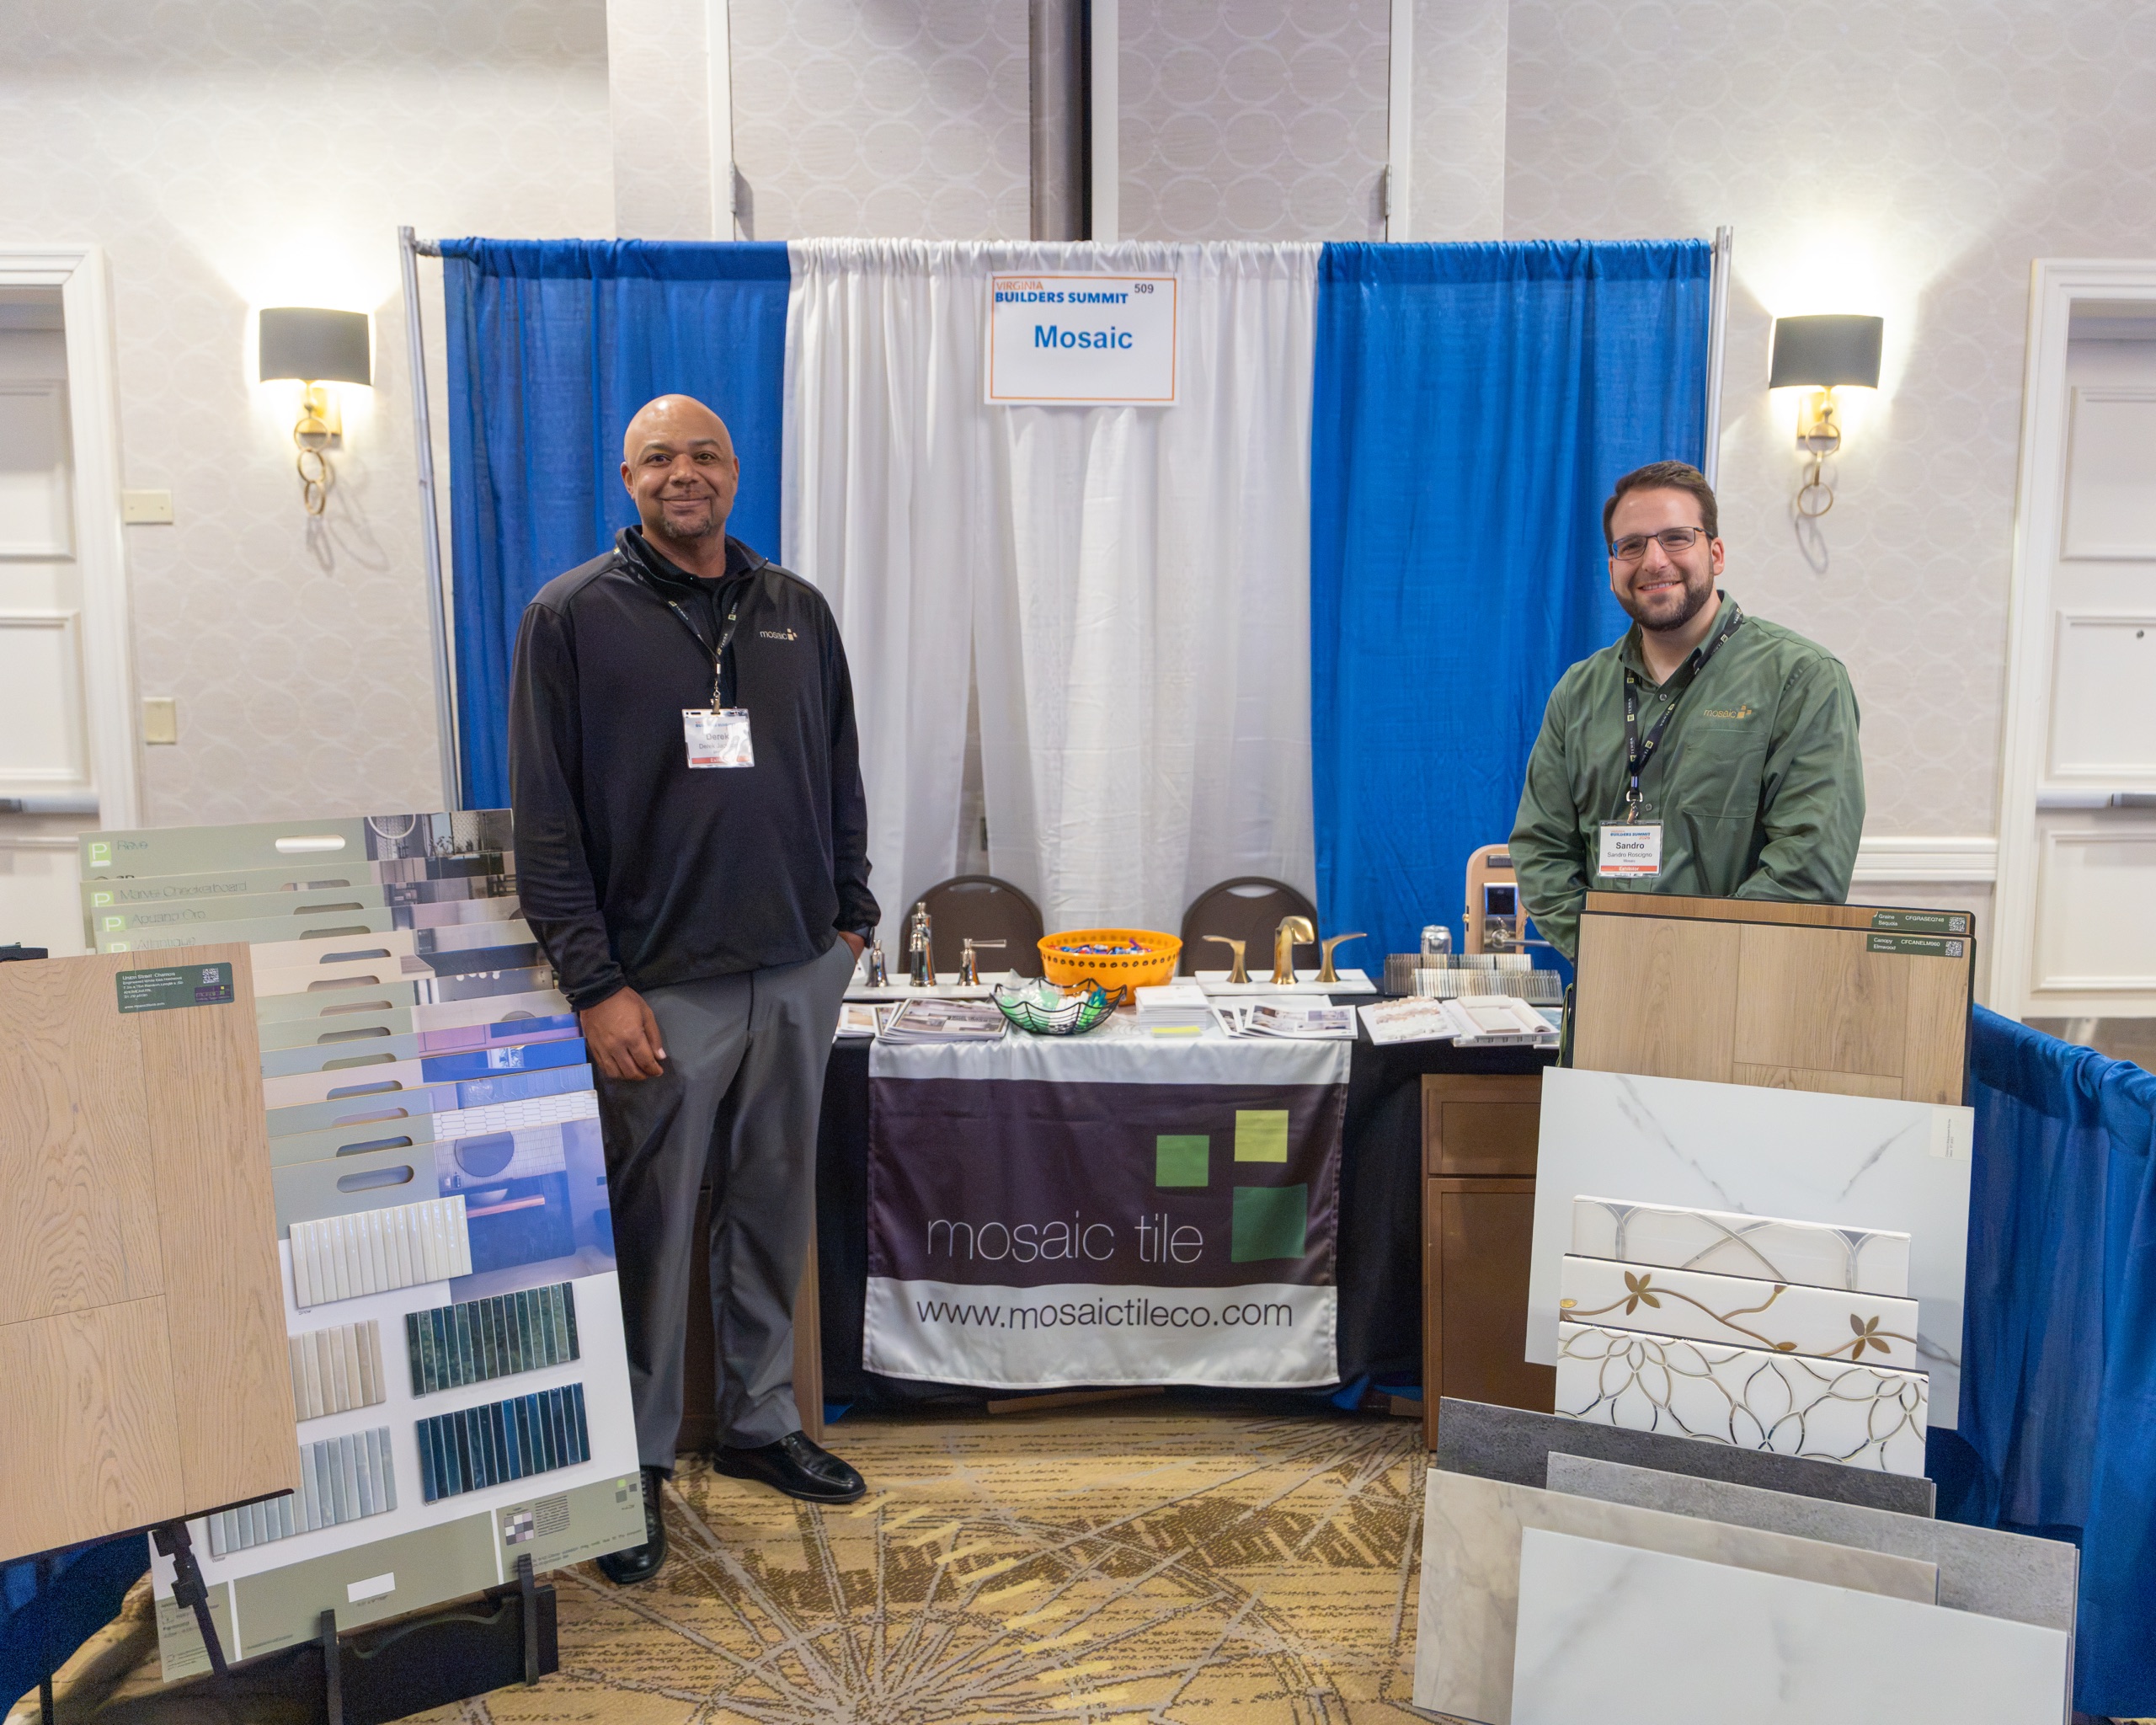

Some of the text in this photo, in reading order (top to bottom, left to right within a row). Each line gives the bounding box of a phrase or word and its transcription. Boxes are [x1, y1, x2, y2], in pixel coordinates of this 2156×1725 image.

[996, 280, 1044, 291] VIRGINIA
[1134, 283, 1155, 294] 509
[995, 291, 1129, 304] BUILDERS SUMMIT
[1034, 324, 1134, 350] Mosaic
[760, 630, 788, 640] mosaic
[1703, 708, 1737, 719] mosaic
[1615, 841, 1645, 850] Sandro
[927, 1210, 1204, 1264] mosaic tile
[916, 1297, 1294, 1330] www.mosaictileco.com
